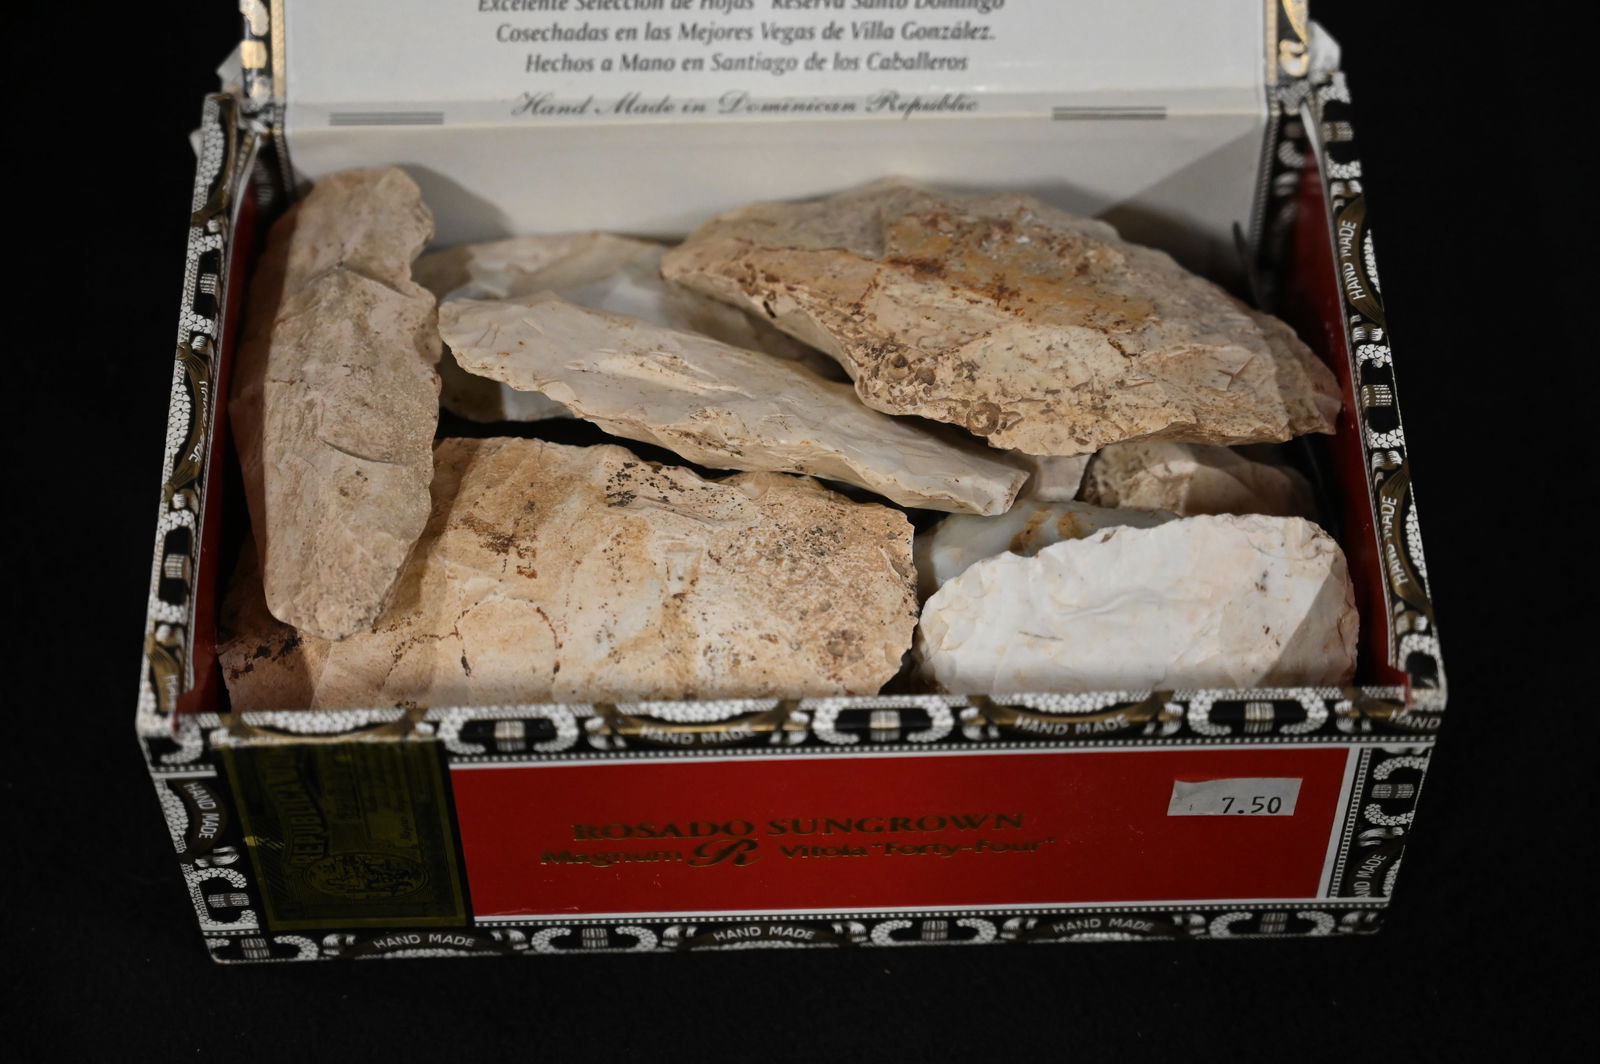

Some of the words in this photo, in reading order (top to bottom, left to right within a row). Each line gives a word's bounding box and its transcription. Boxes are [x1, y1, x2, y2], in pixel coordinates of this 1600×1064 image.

[670, 0, 693, 11] de
[496, 22, 608, 43] Cosechadas
[615, 27, 637, 41] en
[644, 22, 671, 41] las
[678, 21, 754, 46] Mejores
[761, 21, 816, 45] Vegas
[821, 21, 845, 40] de
[851, 20, 895, 40] Villa
[901, 20, 996, 41] González.
[525, 53, 595, 73] Hechos
[600, 58, 613, 72] a
[619, 52, 676, 72] Mano
[681, 57, 704, 71] en
[710, 52, 799, 76] Santiago
[803, 52, 828, 71] de
[833, 51, 860, 71] los
[866, 51, 969, 71] Caballeros
[511, 90, 593, 116] Hand
[594, 90, 675, 116] Made
[681, 102, 707, 113] in
[718, 88, 857, 114] Dominican
[864, 89, 980, 120] Republic
[1338, 219, 1357, 258] MADE
[1343, 262, 1366, 301] HAND
[1380, 495, 1398, 540] MADE
[1014, 714, 1070, 736] HAND
[1074, 713, 1131, 735] MADE
[183, 782, 217, 810] HAND
[1221, 796, 1283, 815] 7.50
[198, 812, 221, 839] MADE
[571, 819, 756, 842] ROSADO
[766, 813, 1024, 837] SUNGROWN
[540, 849, 684, 868] Magnum
[779, 843, 870, 860] Vitola
[1355, 854, 1388, 879] MADE
[712, 926, 762, 941] HAND
[768, 926, 815, 940] MADE
[1052, 918, 1101, 933] HAND
[1108, 918, 1154, 932] MADE
[372, 934, 422, 949] HAND
[428, 933, 475, 948] MADE
